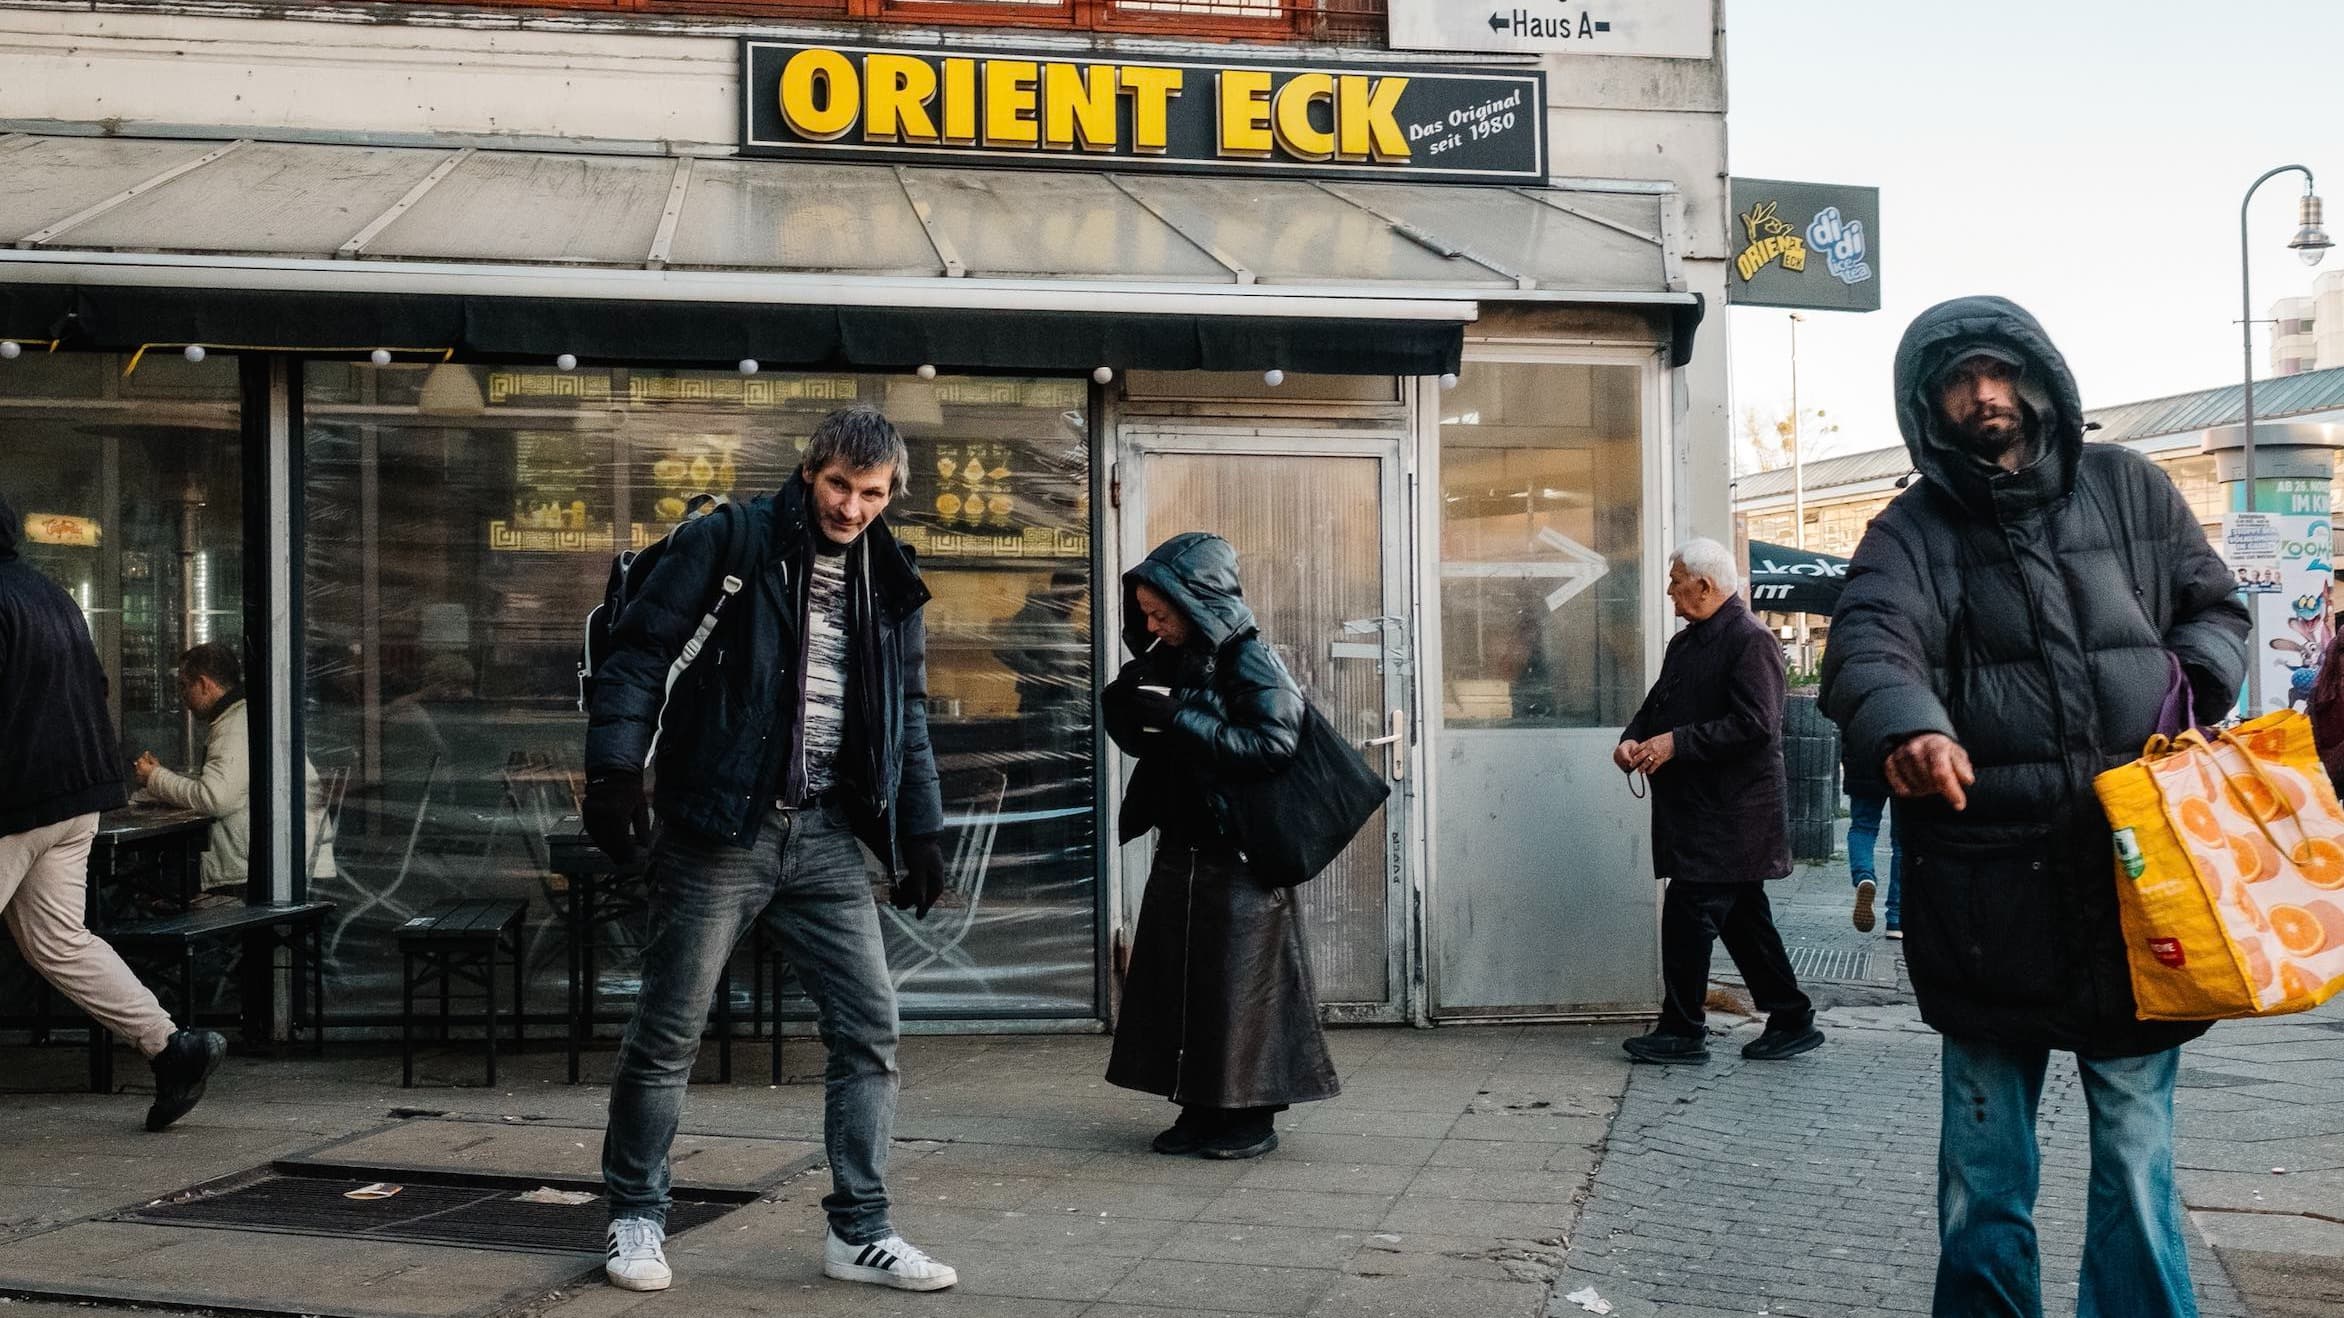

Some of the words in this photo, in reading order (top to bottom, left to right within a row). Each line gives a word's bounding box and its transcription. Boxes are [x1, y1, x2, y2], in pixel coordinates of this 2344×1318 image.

[1513, 9, 1571, 39] Haus
[1578, 11, 1593, 39] A
[779, 48, 1183, 154] ORIENT
[1215, 70, 1411, 163] ECK
[1409, 121, 1443, 141] Das
[1448, 88, 1520, 126] Original
[1430, 133, 1462, 155] seit
[1469, 112, 1515, 140] 1980
[1738, 236, 1803, 280] ORIENT
[2292, 494, 2310, 512] IM
